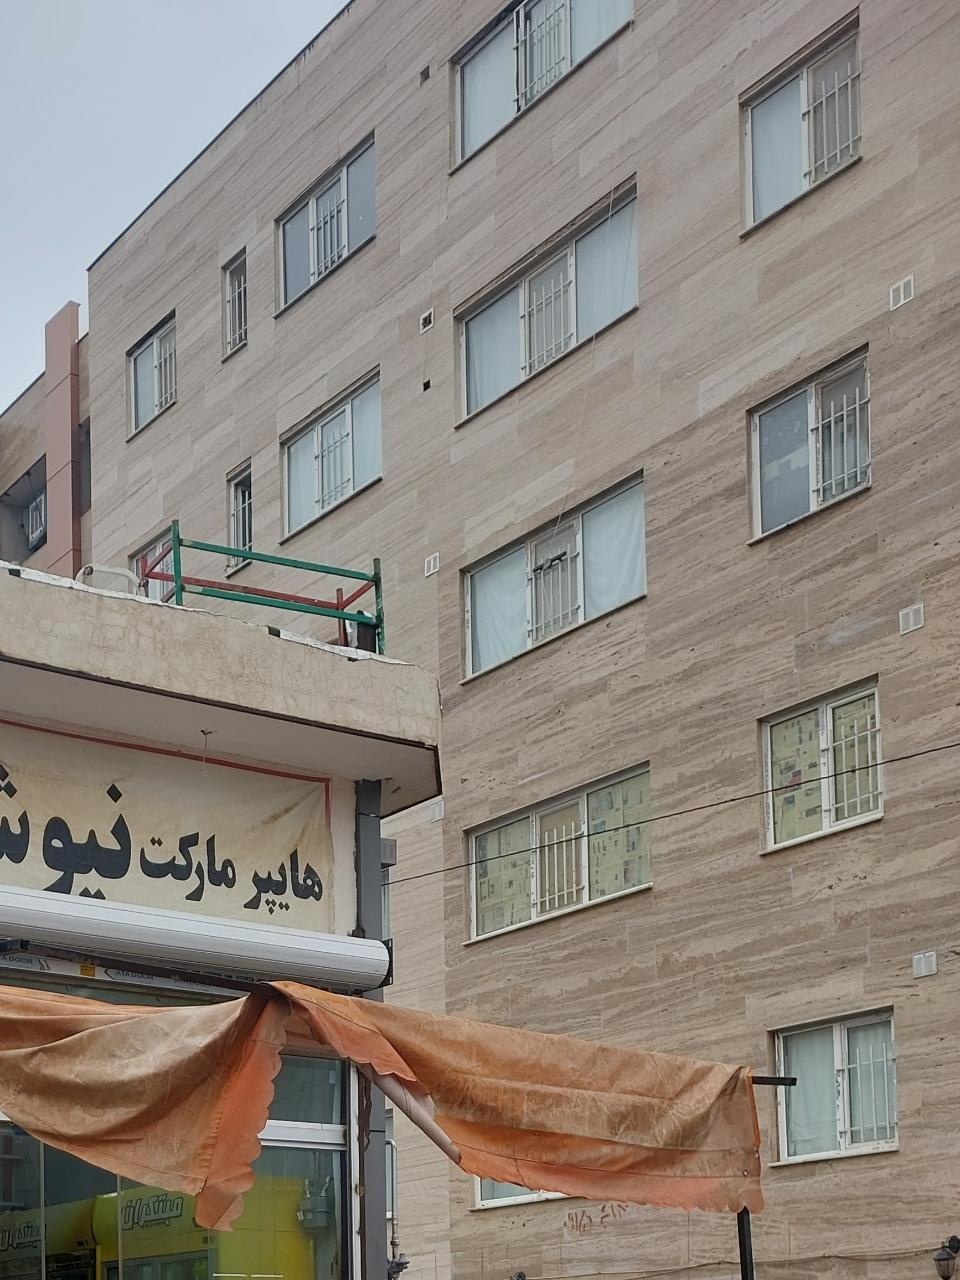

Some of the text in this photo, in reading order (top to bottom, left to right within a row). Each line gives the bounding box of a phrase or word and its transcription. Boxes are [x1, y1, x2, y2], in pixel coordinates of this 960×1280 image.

[140, 832, 237, 901] مارکت
[243, 848, 323, 915] هایپر
[8, 956, 33, 965] DOOR
